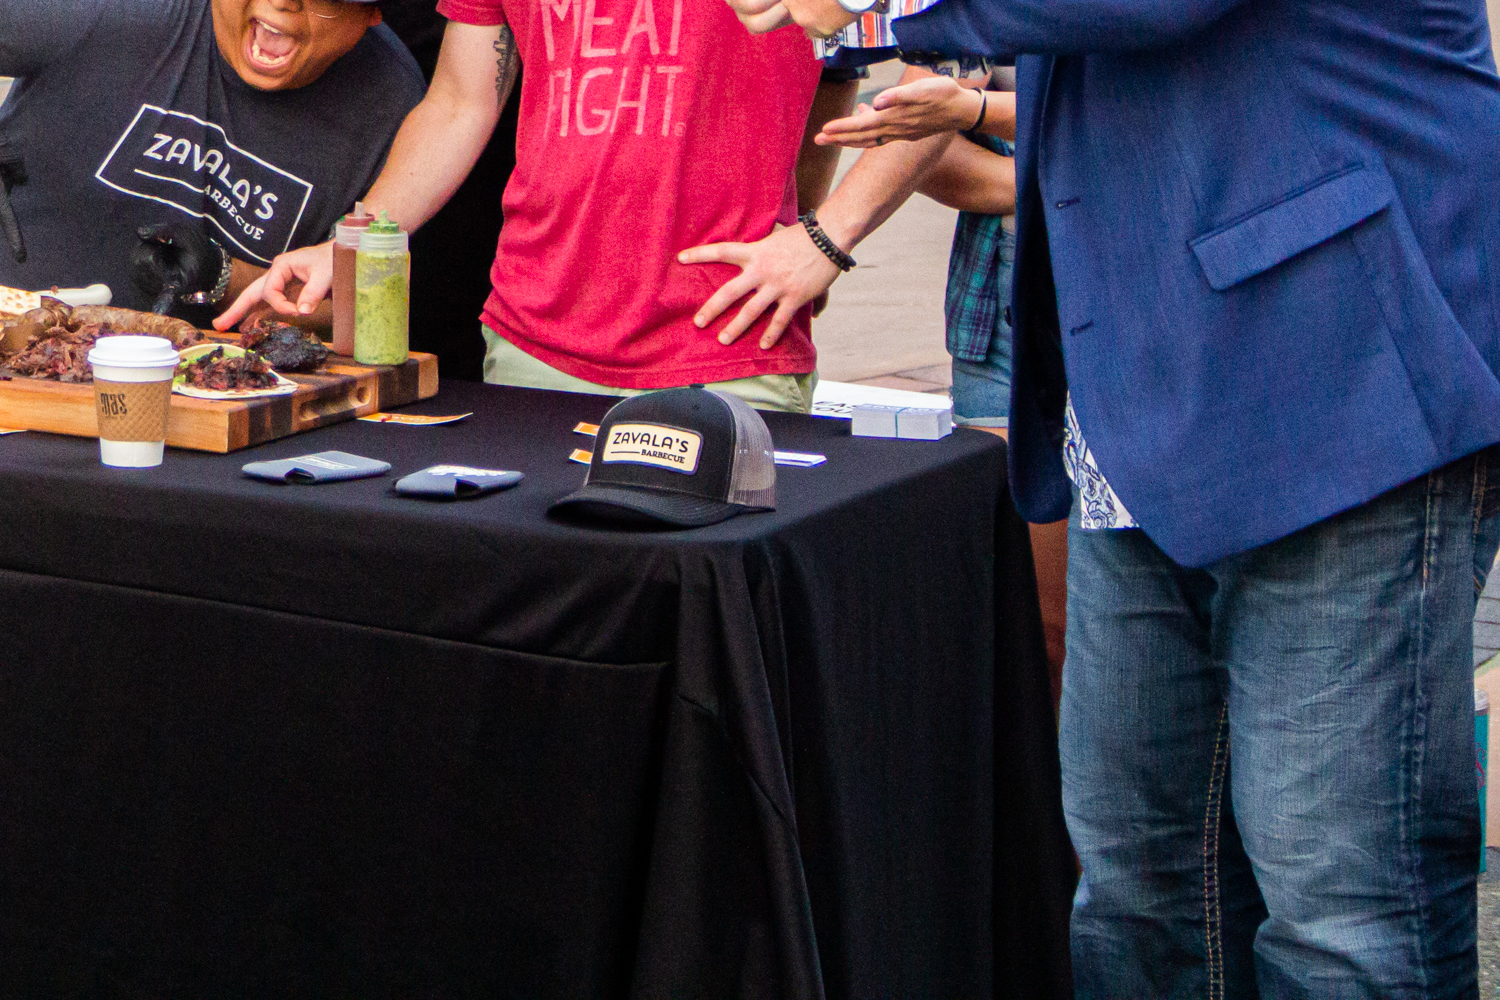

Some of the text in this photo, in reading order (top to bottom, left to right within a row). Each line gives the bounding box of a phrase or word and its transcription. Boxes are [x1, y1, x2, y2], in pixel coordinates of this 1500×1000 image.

[143, 133, 279, 220] ZAVALA'S
[203, 184, 265, 241] ARBECUE
[612, 431, 690, 453] ZAVALA'S
[640, 448, 686, 464] BARBECUE
